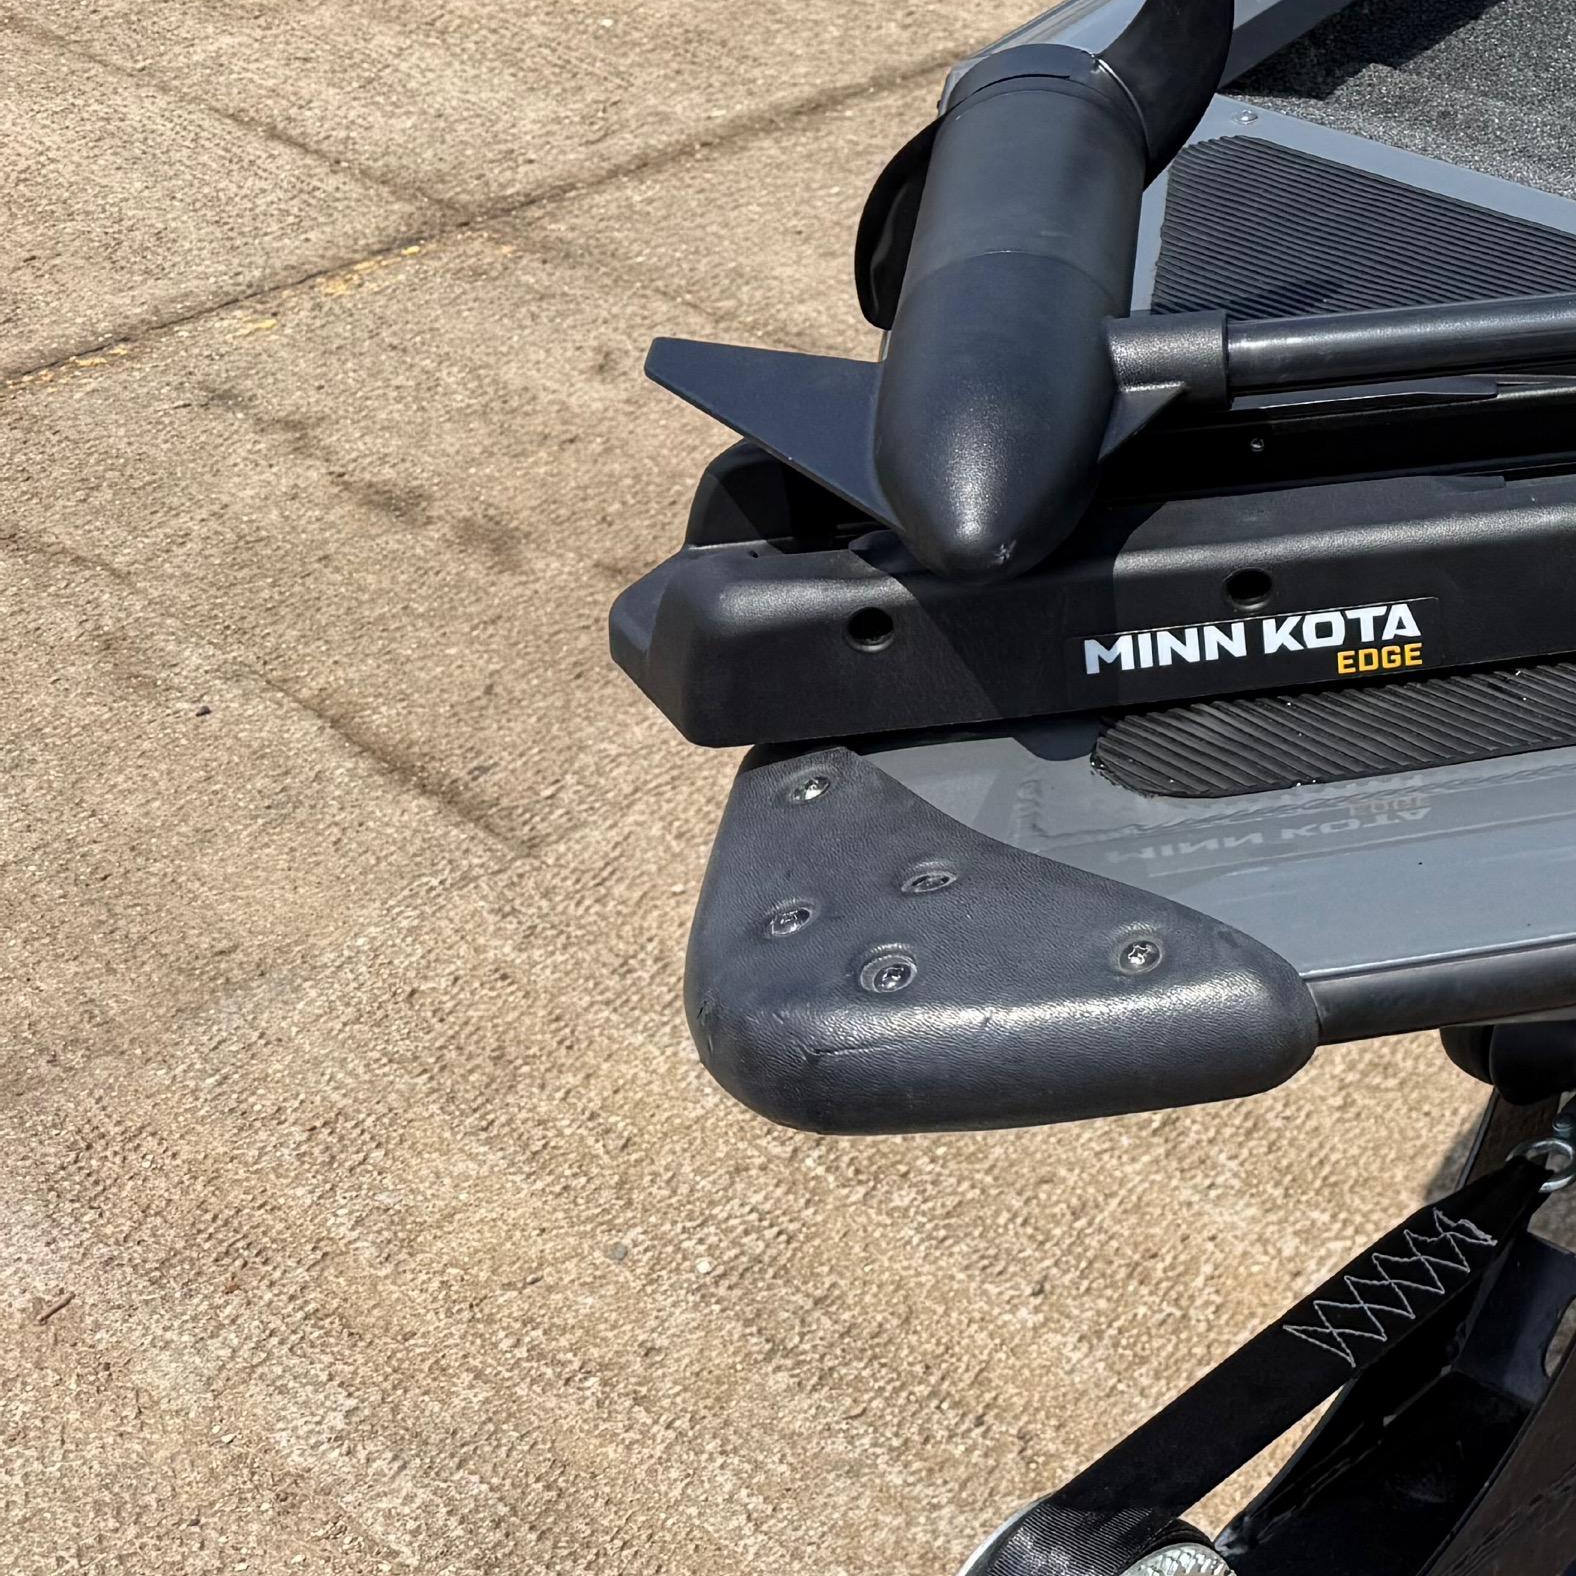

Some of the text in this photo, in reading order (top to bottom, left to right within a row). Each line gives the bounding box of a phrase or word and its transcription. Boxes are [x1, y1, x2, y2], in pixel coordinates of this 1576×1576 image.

[1084, 603, 1421, 674] MINN KOTA
[1337, 642, 1423, 674] EDGE
